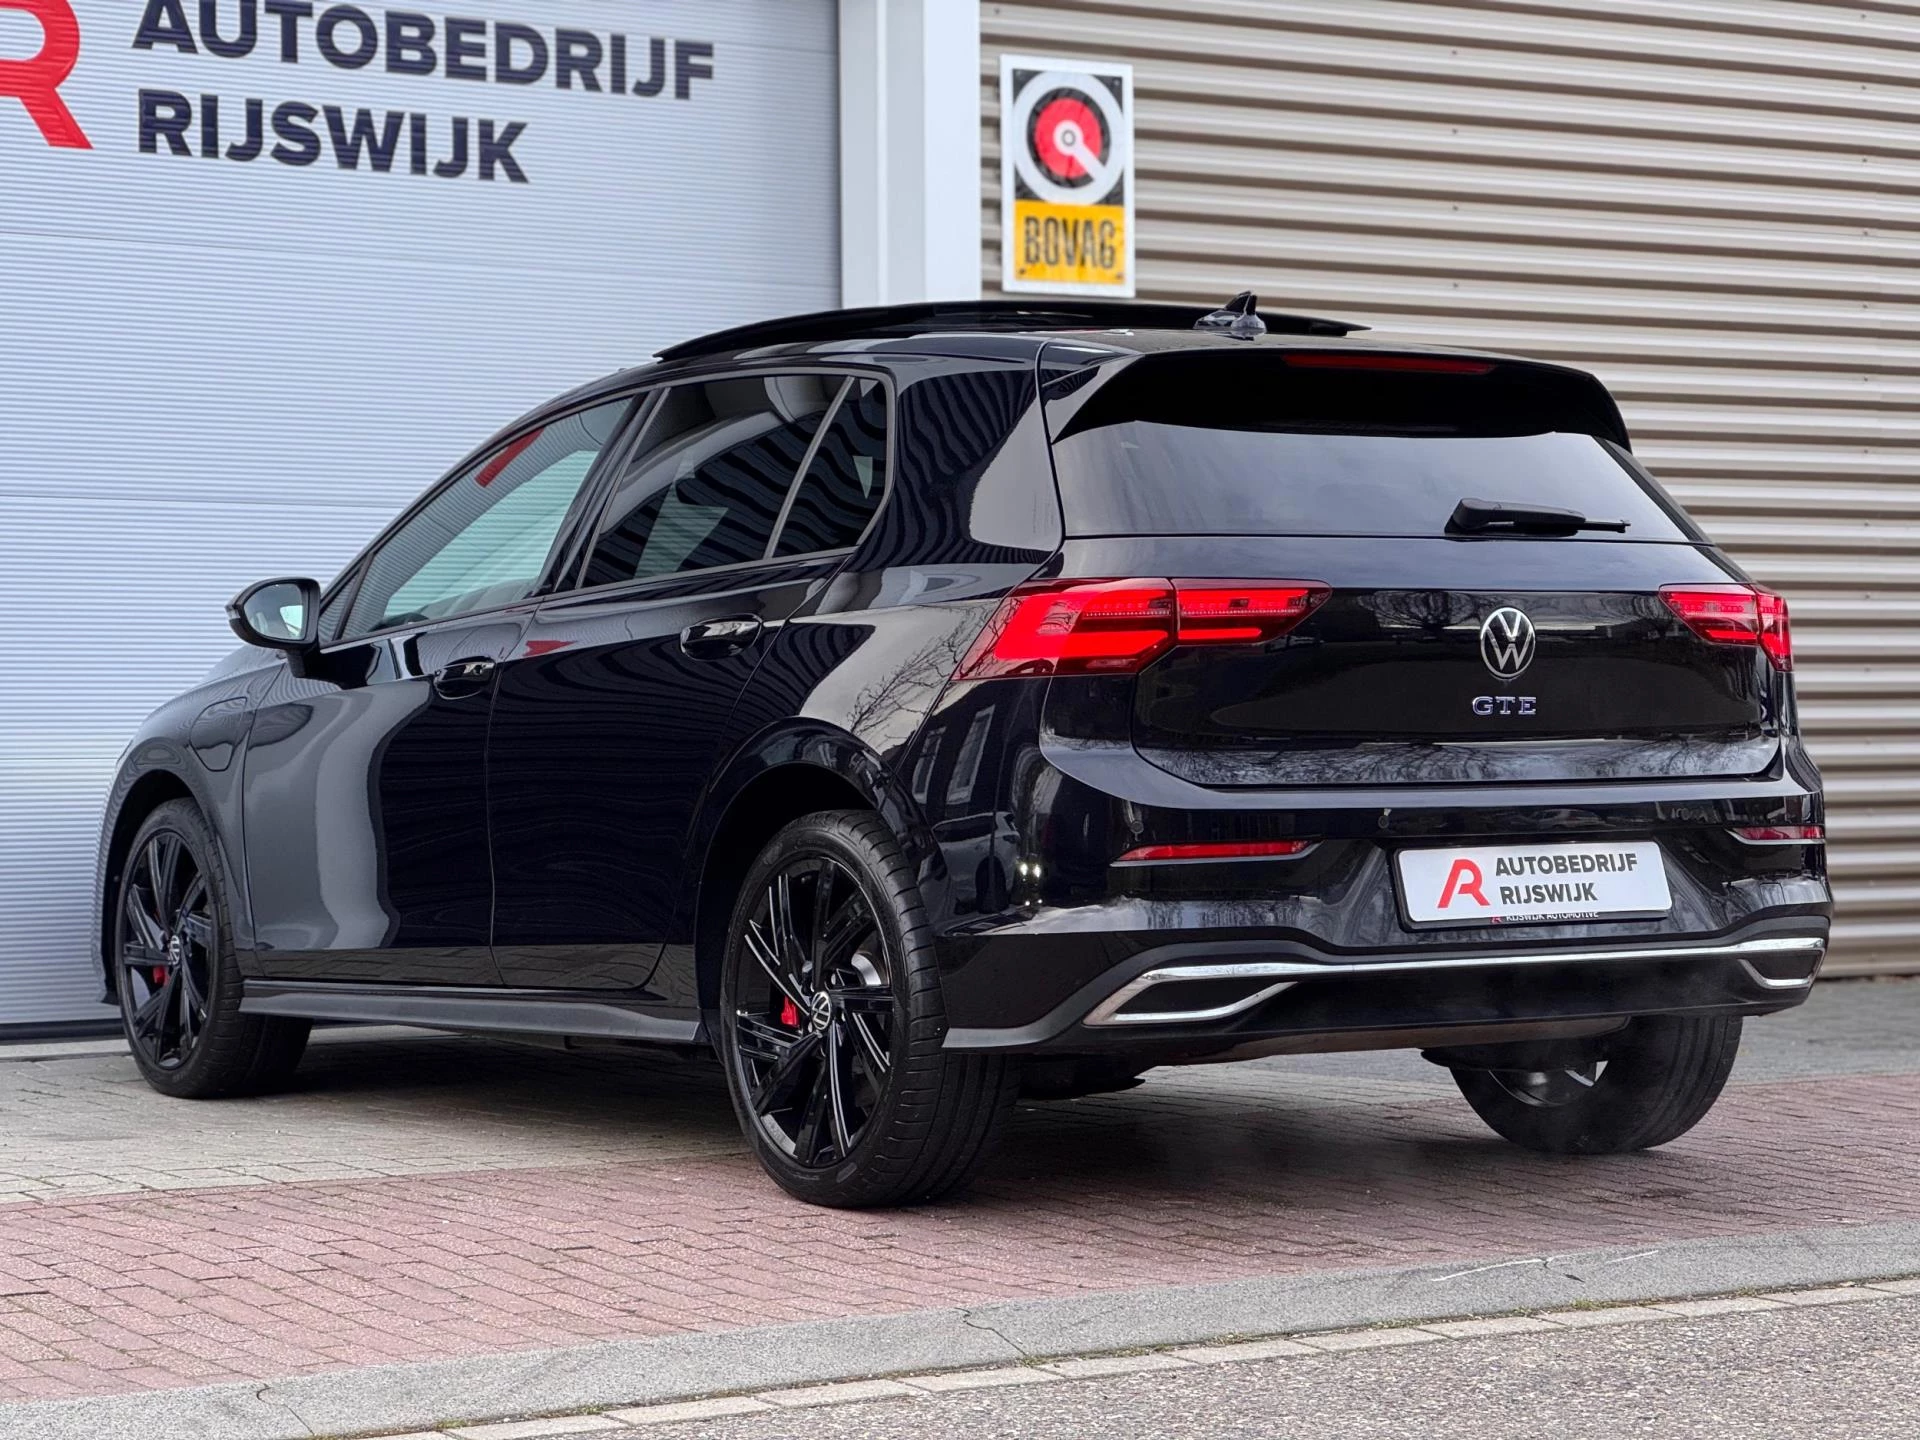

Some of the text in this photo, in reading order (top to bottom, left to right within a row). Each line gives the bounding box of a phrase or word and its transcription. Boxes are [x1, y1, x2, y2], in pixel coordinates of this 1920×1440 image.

[132, 0, 713, 99] AUTOBEDRIJF
[138, 89, 529, 183] RIJSWIJK
[1024, 215, 1115, 268] BOVAG
[1472, 696, 1537, 715] GTE
[1495, 853, 1637, 876] AUTOBEDRIJF
[1499, 882, 1598, 905] RIJSWIJK
